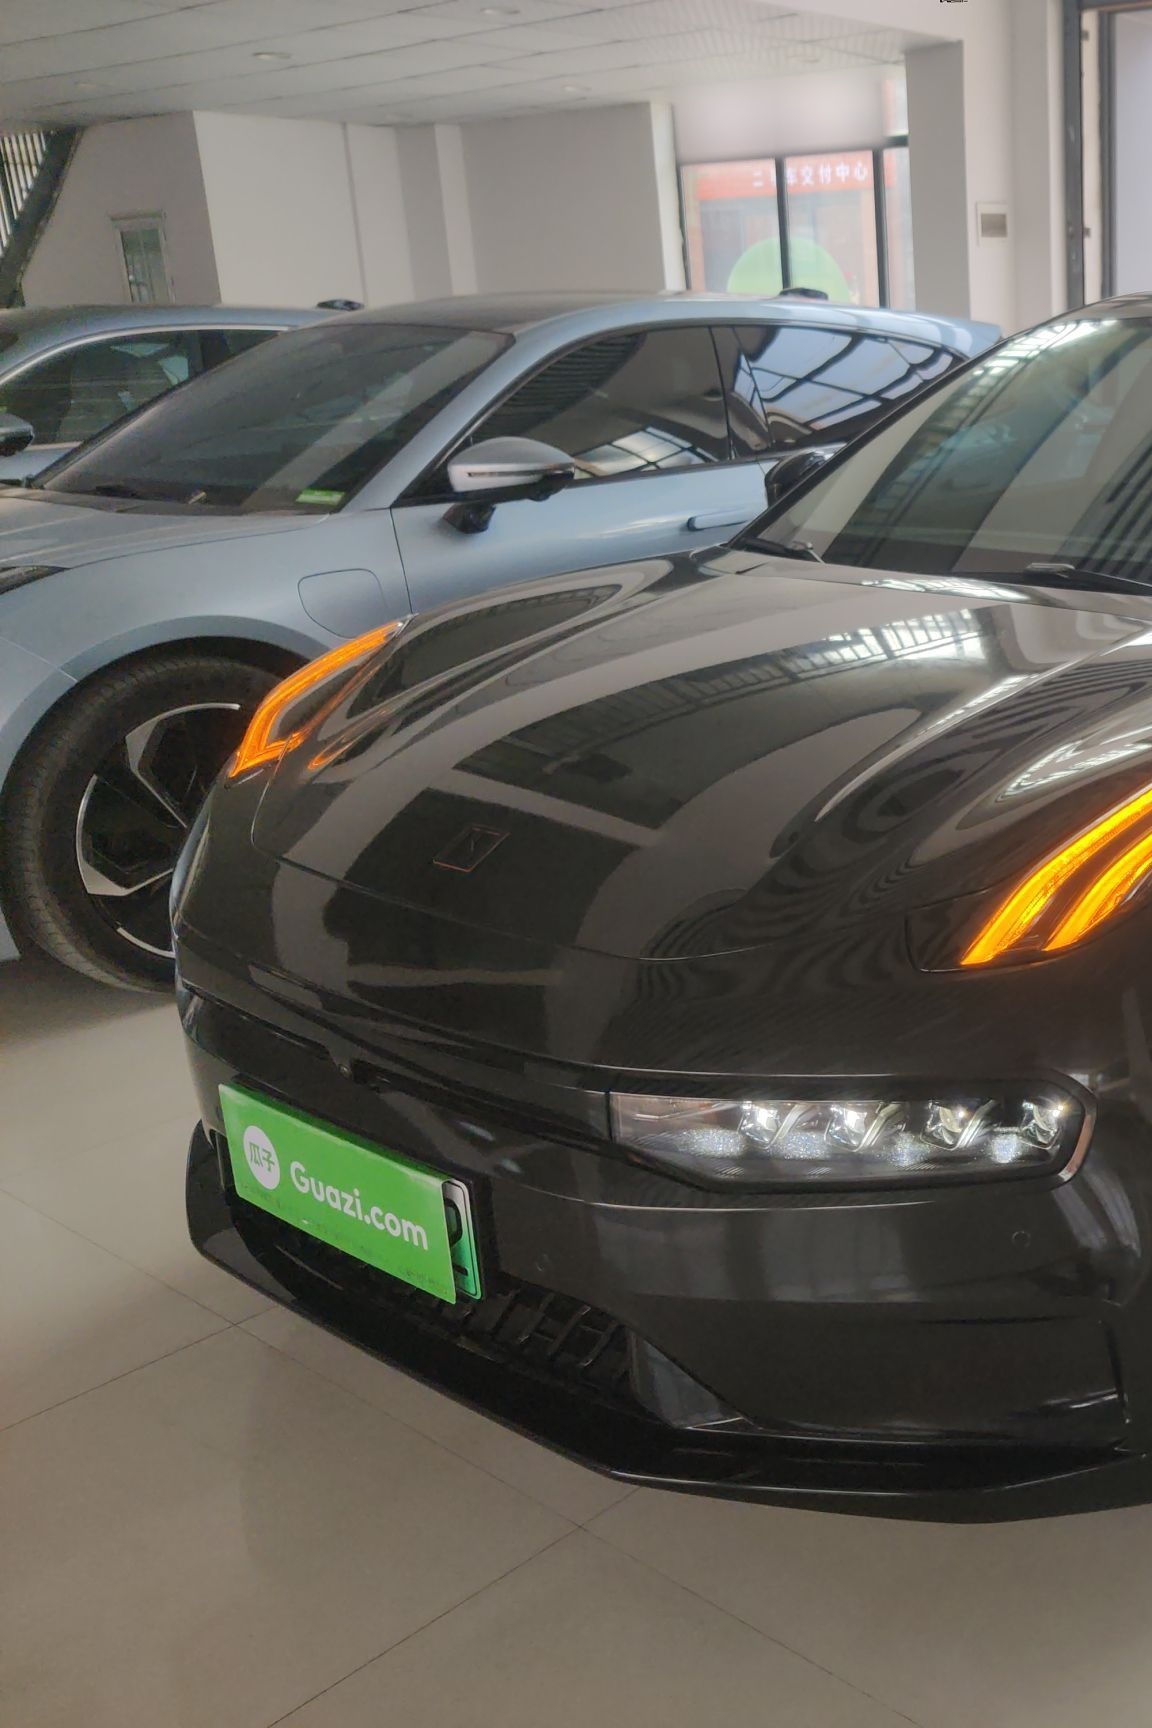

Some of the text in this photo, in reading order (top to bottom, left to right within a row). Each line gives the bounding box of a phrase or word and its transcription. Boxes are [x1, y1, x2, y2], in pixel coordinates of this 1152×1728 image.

[752, 160, 869, 188] 二车交付中心
[249, 1140, 276, 1174] 瓜子
[289, 1160, 429, 1251] Guazi.com
